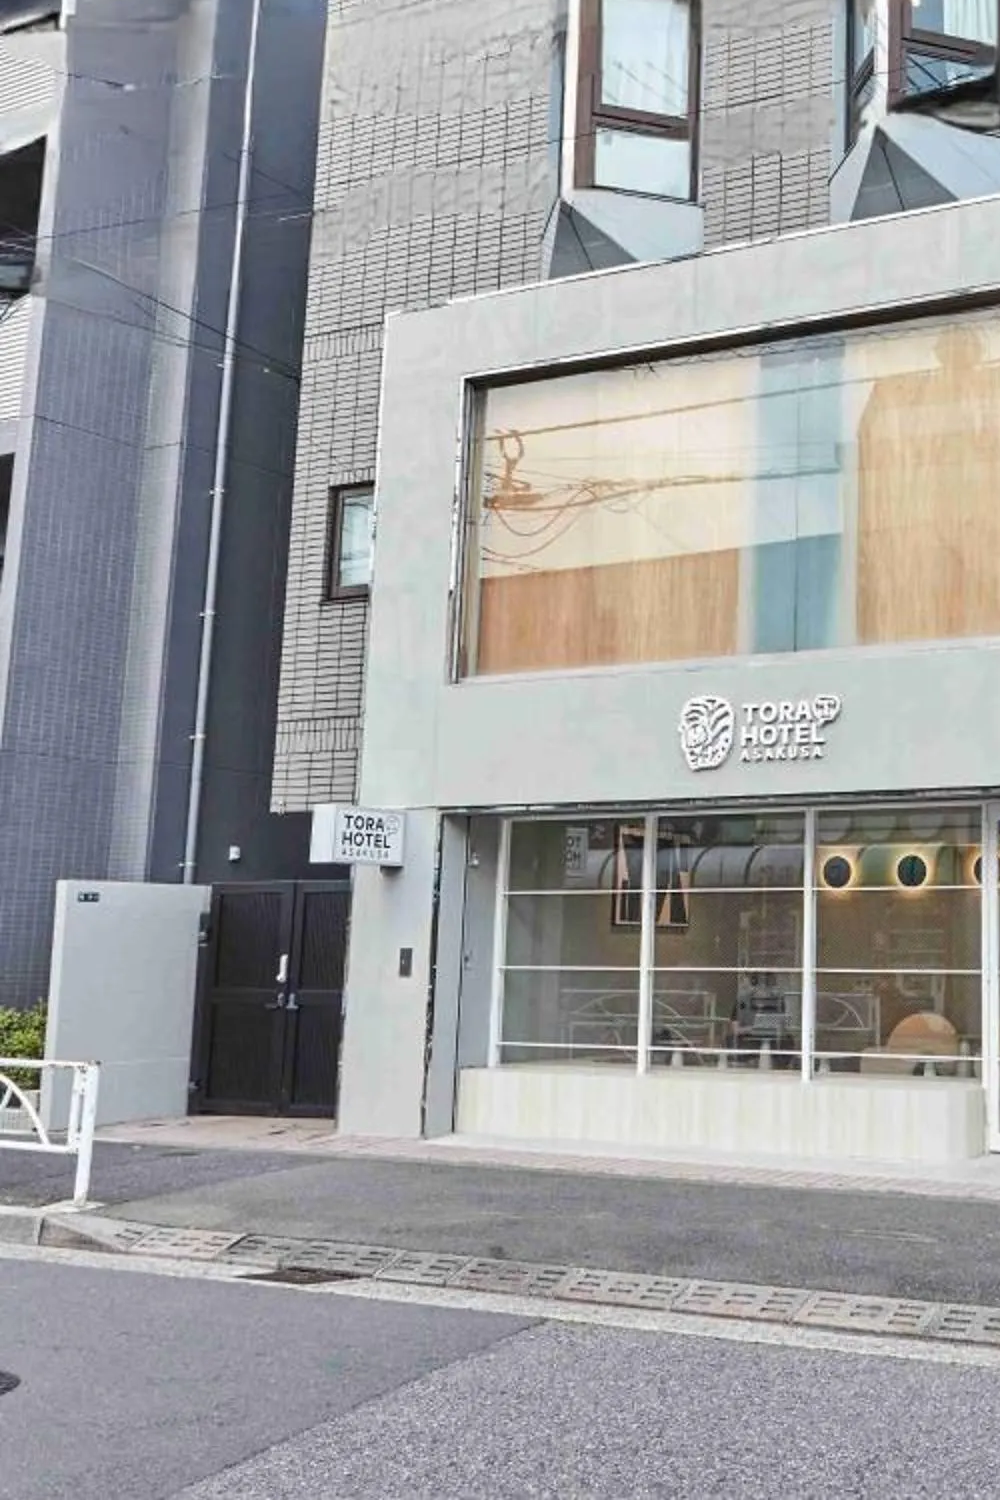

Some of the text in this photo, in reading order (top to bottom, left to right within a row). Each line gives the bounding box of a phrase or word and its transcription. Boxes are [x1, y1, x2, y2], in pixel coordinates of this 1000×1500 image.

[741, 701, 813, 723] TORA
[740, 723, 826, 747] HOTEL
[740, 746, 824, 762] ASAKUSA
[344, 814, 385, 832] TORA
[341, 831, 391, 849] HOTEL
